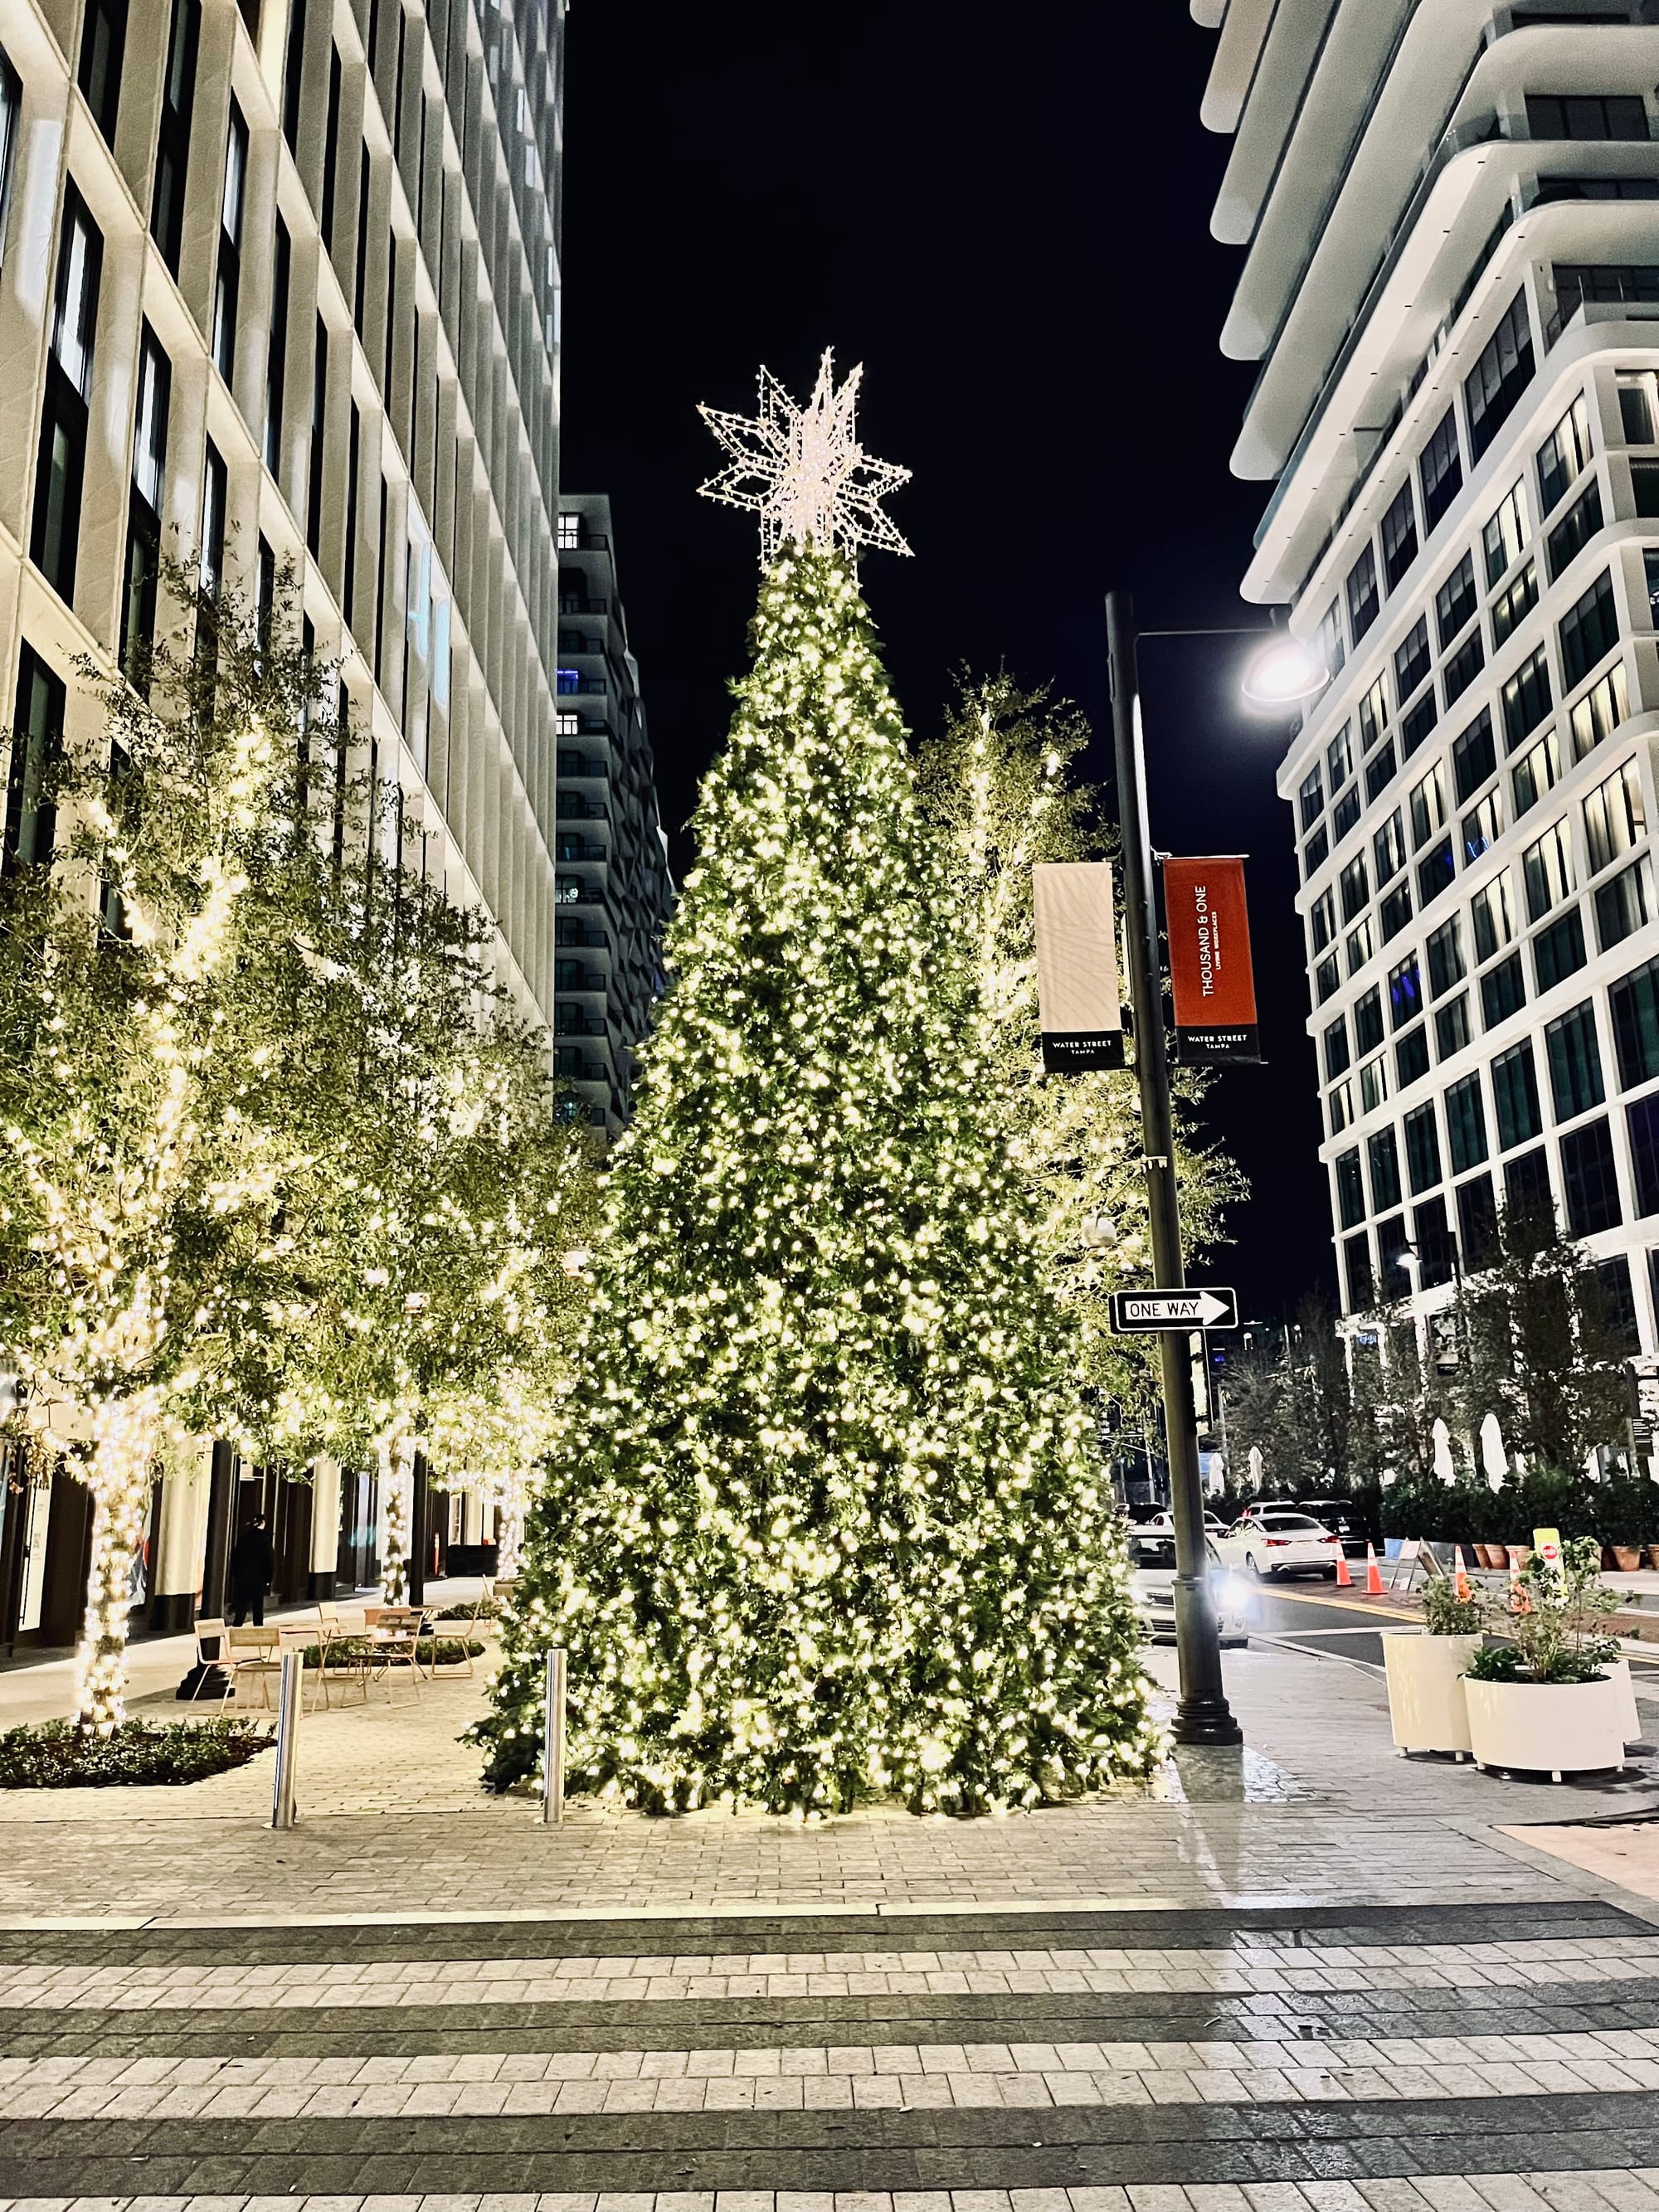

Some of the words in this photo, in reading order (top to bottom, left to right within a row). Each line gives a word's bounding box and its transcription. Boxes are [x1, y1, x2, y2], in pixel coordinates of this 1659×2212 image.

[1195, 886, 1208, 912] ONE
[1197, 916, 1209, 924] &
[1199, 927, 1214, 997] THOUSAND
[1130, 1303, 1161, 1317] ONE
[1167, 1302, 1199, 1315] WAY
